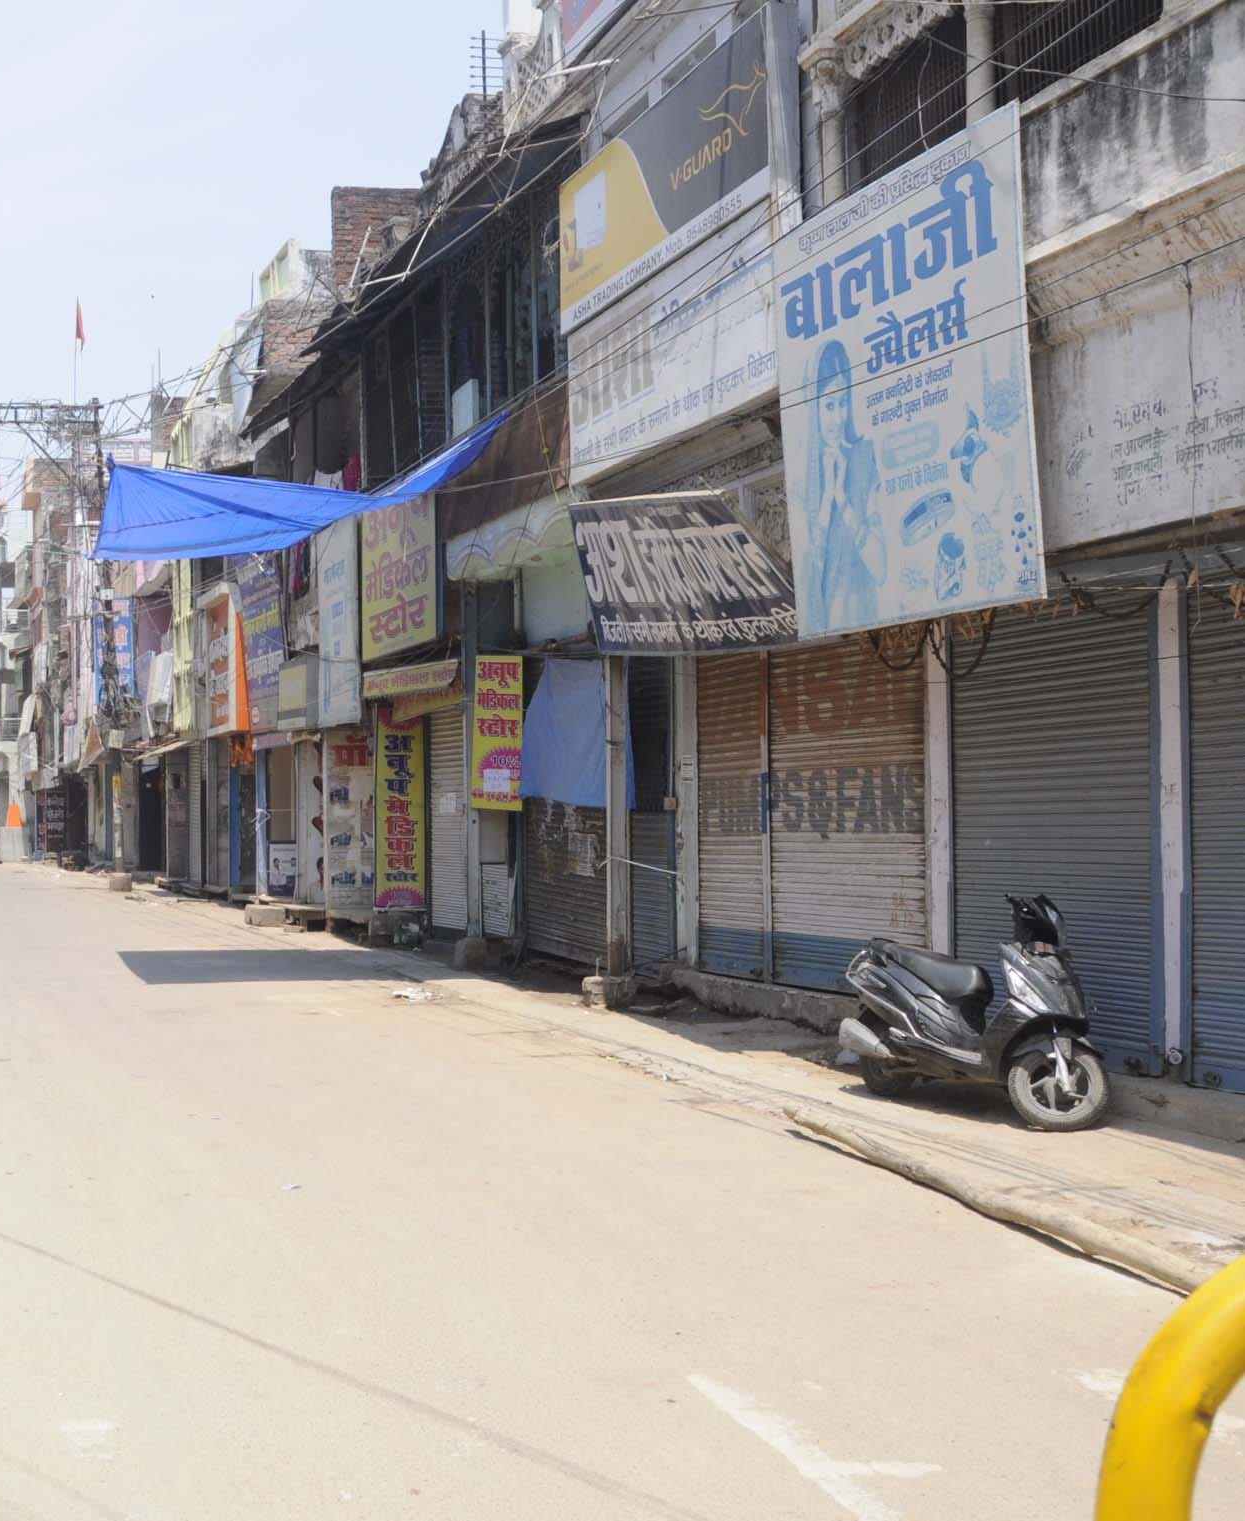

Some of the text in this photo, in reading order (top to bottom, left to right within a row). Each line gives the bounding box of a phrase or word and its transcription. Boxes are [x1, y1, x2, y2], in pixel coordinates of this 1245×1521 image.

[670, 128, 732, 191] V-GUARD
[781, 160, 998, 341] बालाजी
[573, 299, 593, 323] ASHA
[593, 279, 624, 313] TRADING
[863, 277, 969, 374] ज्वैलर्स
[365, 545, 431, 603] मेडिकल
[575, 519, 658, 603] आशा
[369, 592, 428, 643] स्टोर
[477, 661, 520, 688] अनूप
[477, 688, 520, 711] मेडिकल
[477, 714, 520, 737] स्टोर
[491, 754, 522, 769] 10%
